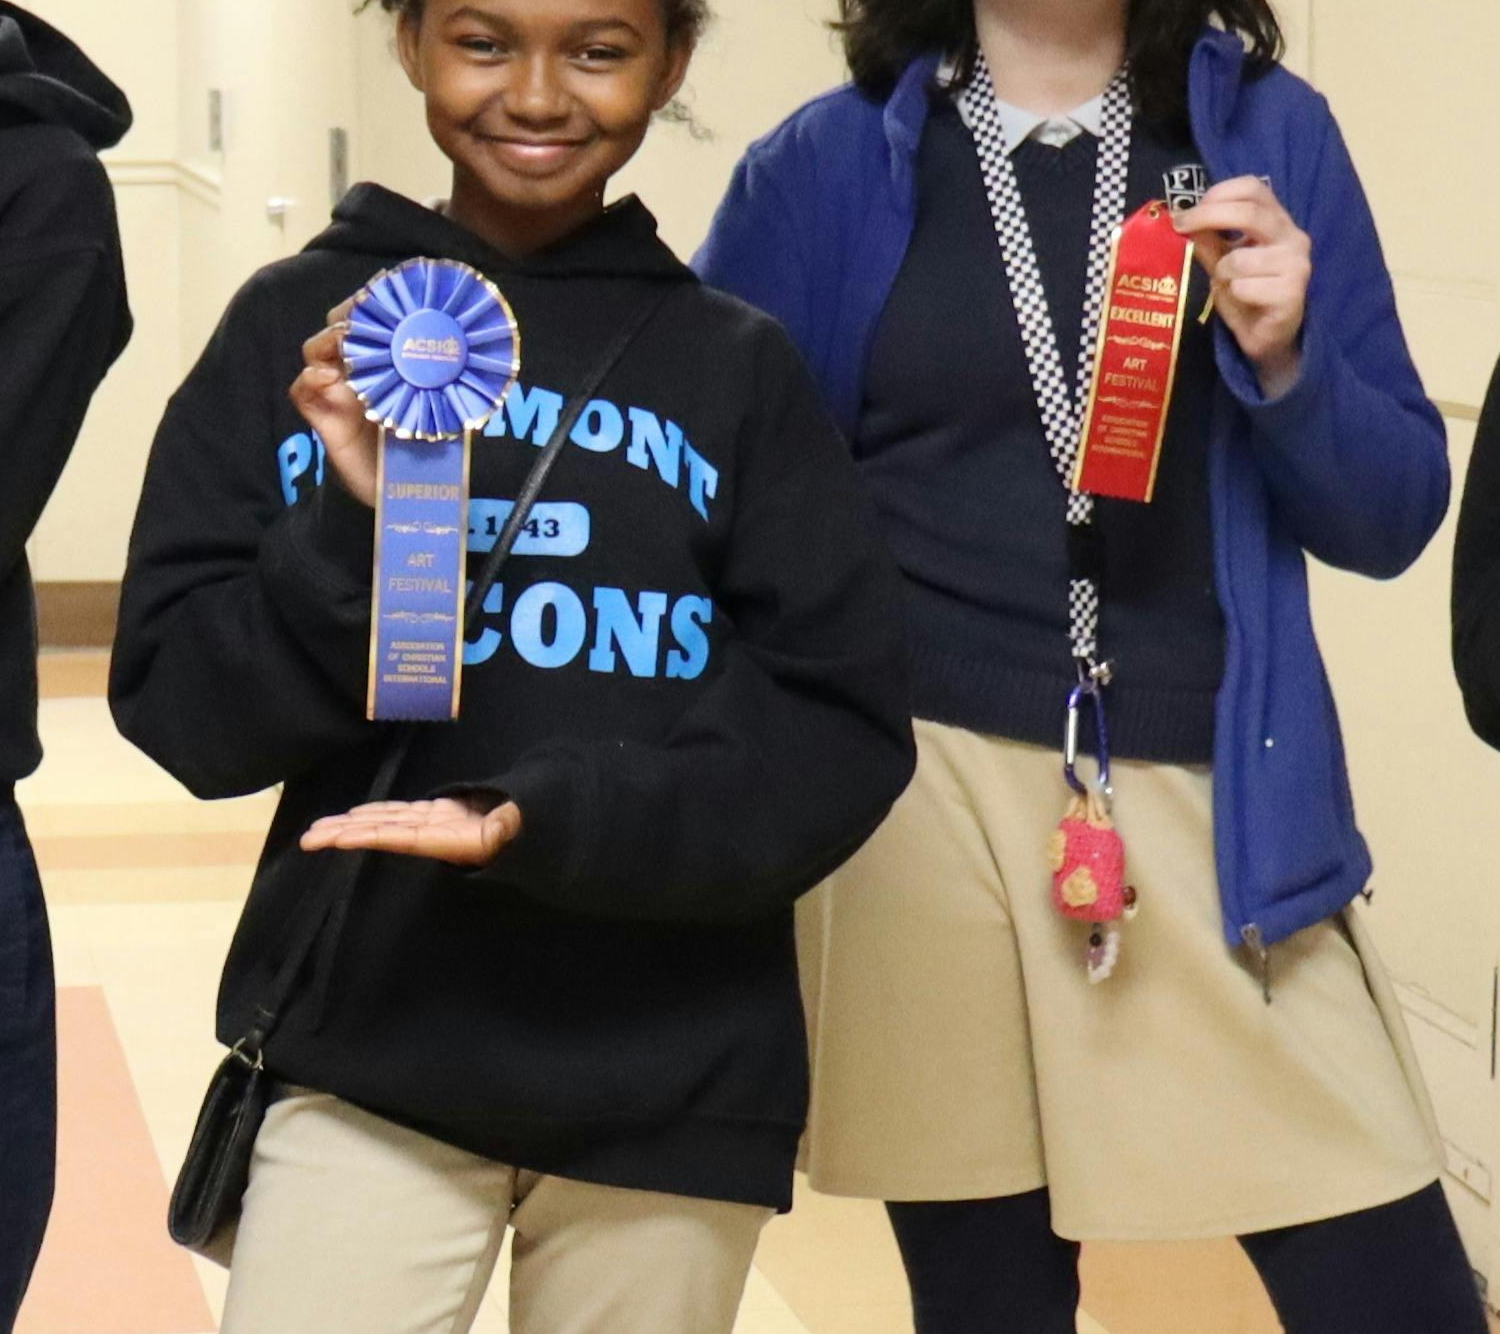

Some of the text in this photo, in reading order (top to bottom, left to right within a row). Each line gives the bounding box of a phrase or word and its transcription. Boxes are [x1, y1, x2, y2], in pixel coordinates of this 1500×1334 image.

[1117, 273, 1159, 292] ACSI
[1110, 305, 1176, 329] EXCELLENT
[1122, 356, 1149, 371] ART
[1103, 371, 1159, 392] FESTIVAL
[387, 482, 460, 500] SUPERIOR
[485, 515, 561, 539] 143
[407, 553, 436, 568] ART
[388, 577, 452, 594] FESTIVAL
